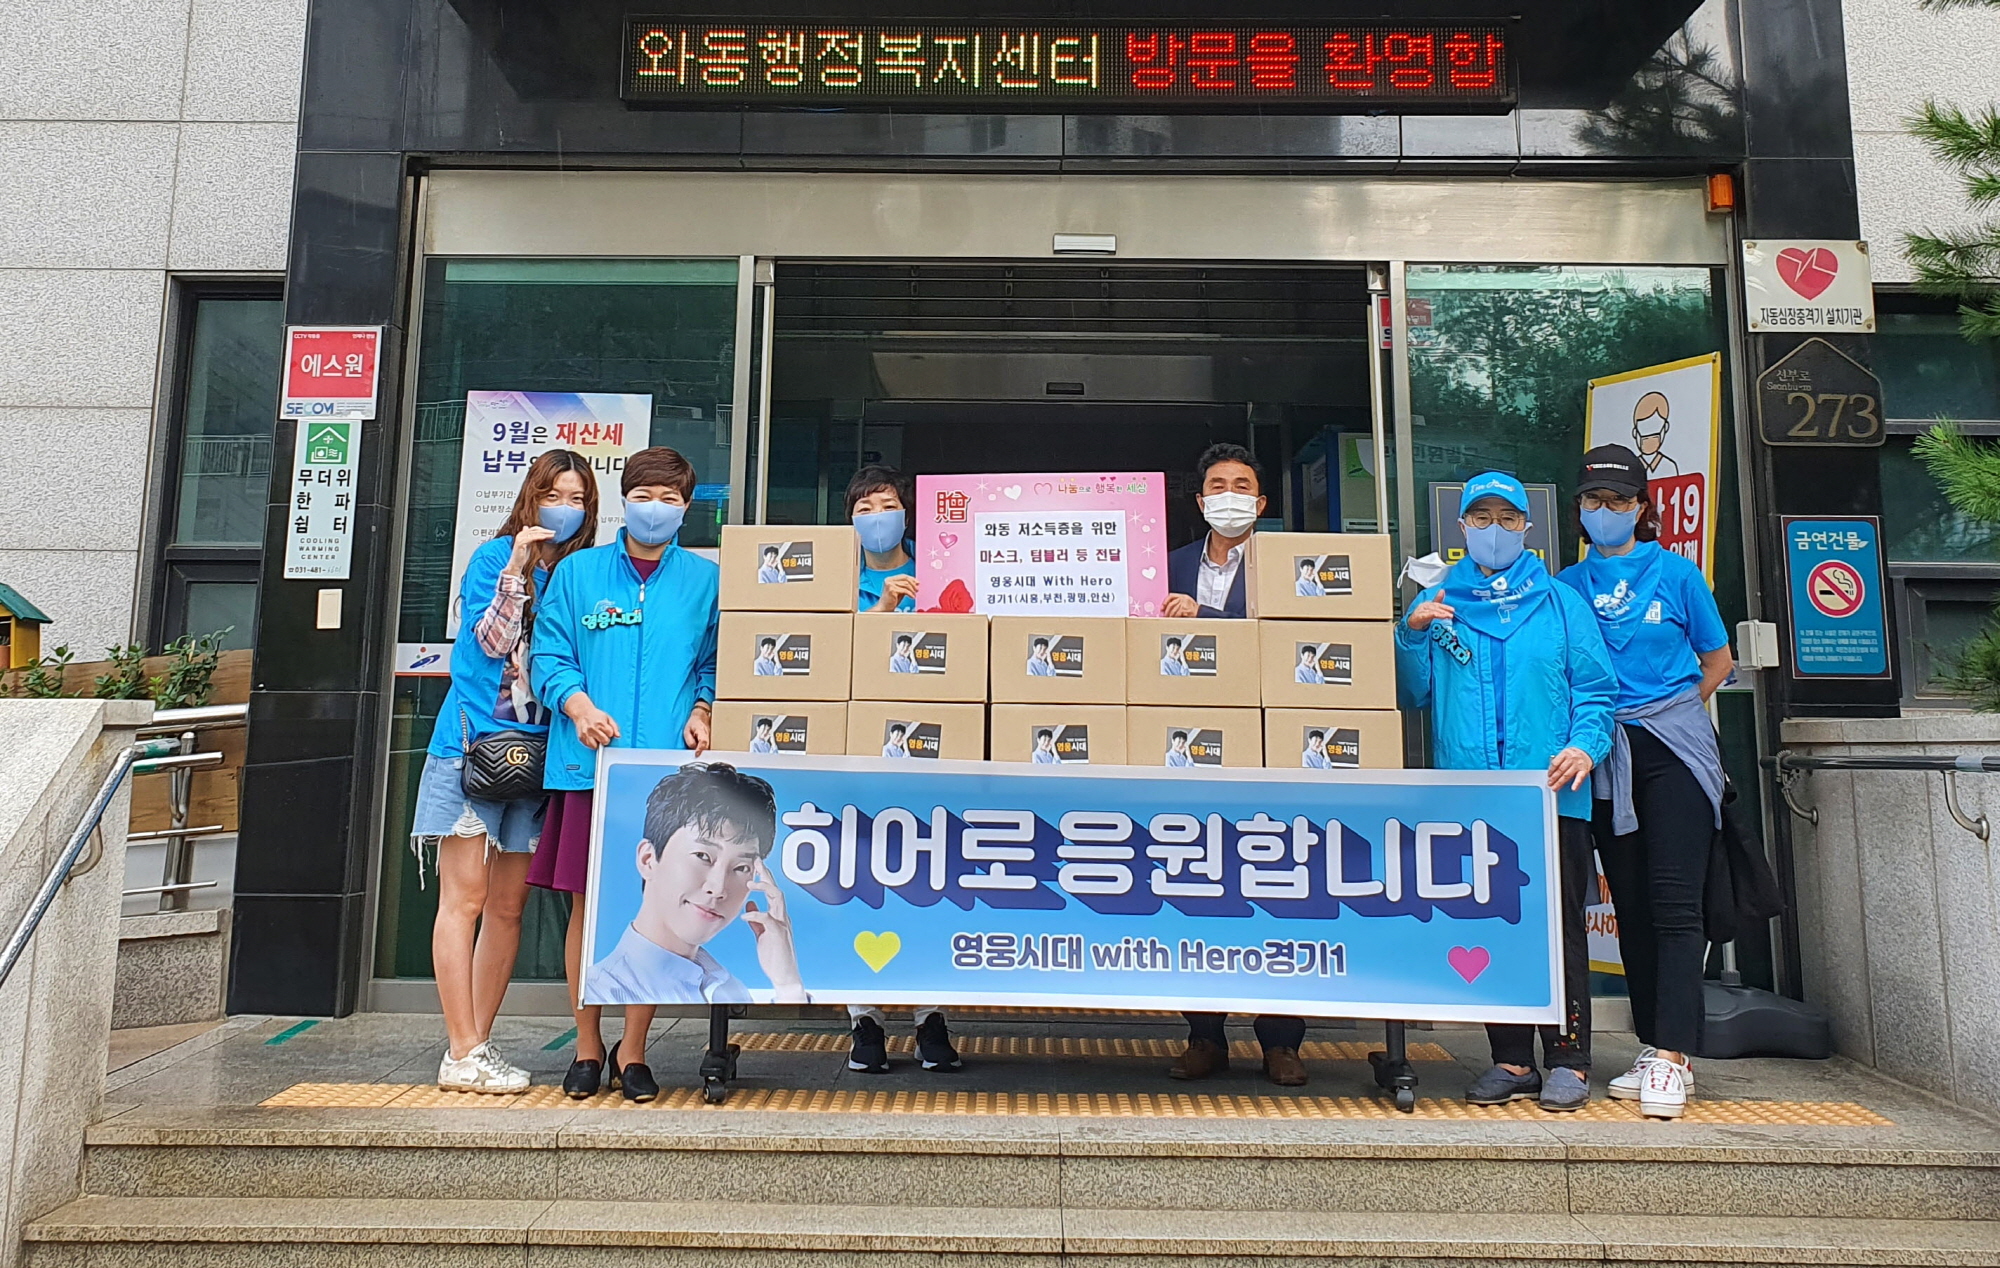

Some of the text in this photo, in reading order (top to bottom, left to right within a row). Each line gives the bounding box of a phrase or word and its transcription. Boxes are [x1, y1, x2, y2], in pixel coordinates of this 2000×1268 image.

[638, 30, 1504, 89] 와동행정복지센터 방문을 환영합
[1760, 307, 1863, 326] 자동심장충격기 설치기관
[300, 353, 364, 378] 에스원
[1775, 369, 1812, 382] 선부로
[1786, 392, 1879, 438] 273
[492, 420, 624, 446] 9월은 재산세
[297, 468, 352, 487] 무더위
[1058, 483, 1147, 494] 나눔으로 행복한 세상
[935, 490, 972, 523] 贈
[984, 522, 1011, 537] 와동
[1091, 521, 1117, 536] 위한
[1794, 531, 1862, 551] 금연건물
[980, 548, 1122, 563] 마스크, 텀블러 등 전달
[782, 557, 812, 568] 영웅시대
[990, 574, 1113, 588] 영웅시대 With Hero
[1319, 570, 1350, 582] 영웅시대
[779, 650, 809, 661] 영웅시대
[915, 648, 945, 660] 영웅시대
[1052, 651, 1082, 662] 영웅시대
[1185, 651, 1215, 662] 영웅시대
[1320, 659, 1350, 671] 영웅시대
[775, 732, 806, 743] 영웅시대
[908, 738, 939, 751] 영웅시대
[1056, 741, 1087, 752] 영웅시대
[1191, 744, 1221, 757] 영웅시대
[1327, 744, 1358, 756] 영웅시대
[951, 932, 1348, 978] 영웅시대 with Hero경기1
